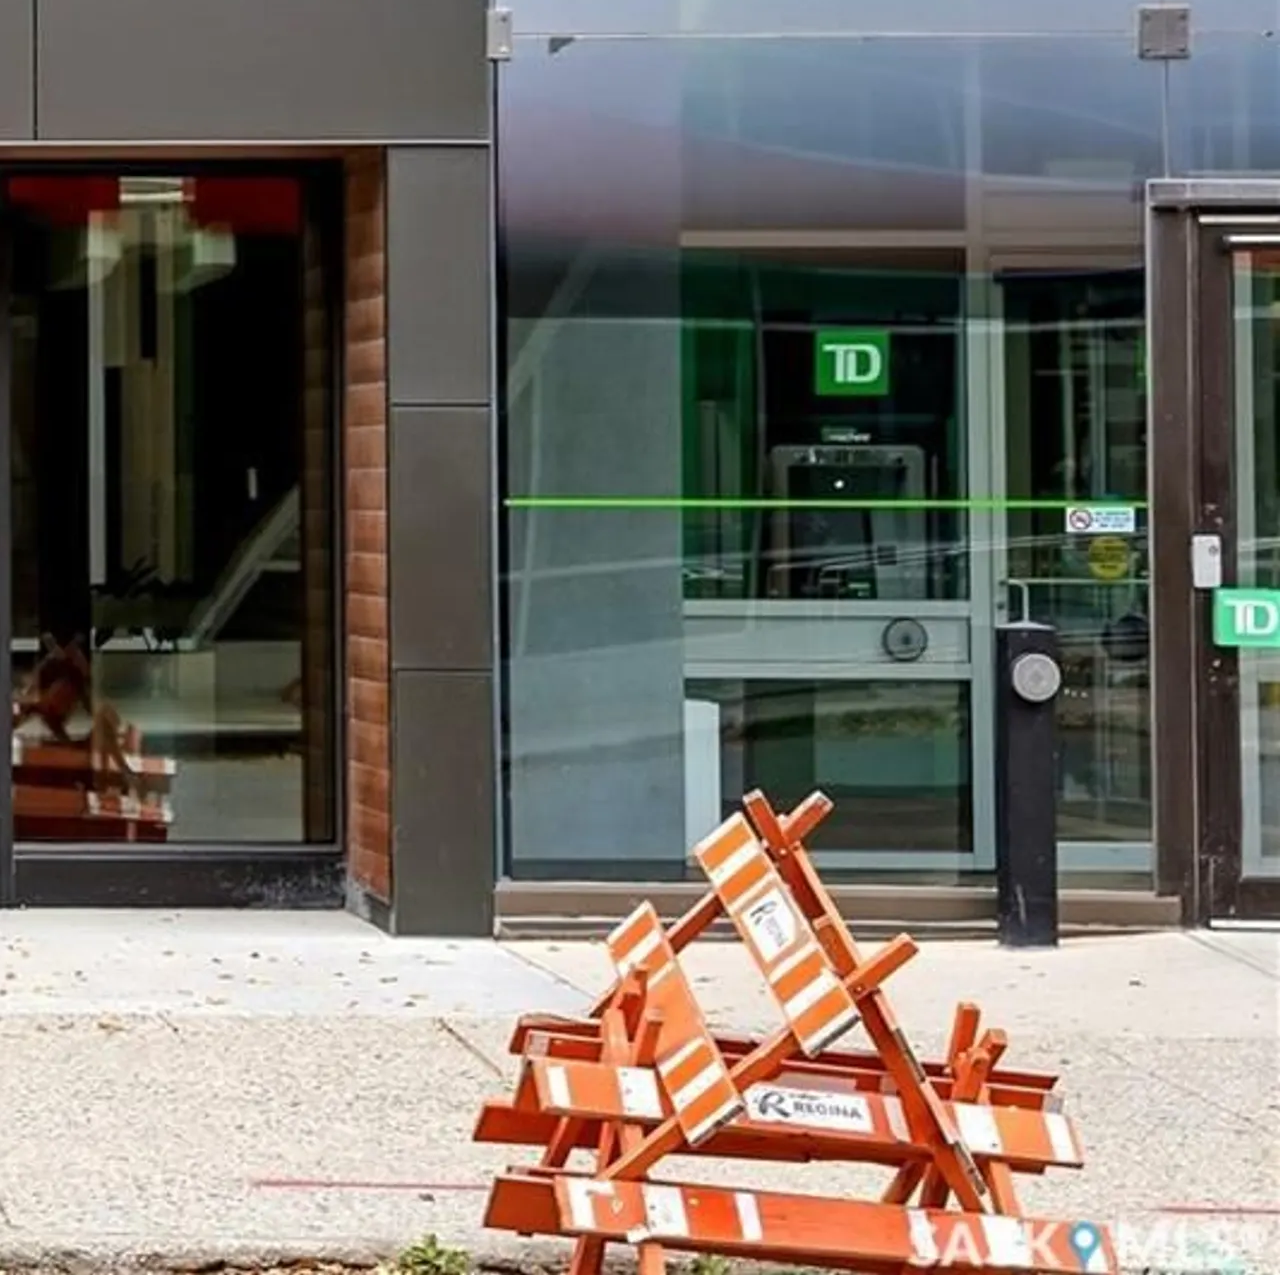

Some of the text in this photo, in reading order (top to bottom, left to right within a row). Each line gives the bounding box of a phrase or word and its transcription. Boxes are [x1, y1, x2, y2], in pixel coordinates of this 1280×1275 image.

[822, 343, 881, 383] TD
[1223, 600, 1279, 635] TD
[793, 1101, 865, 1121] REGINA
